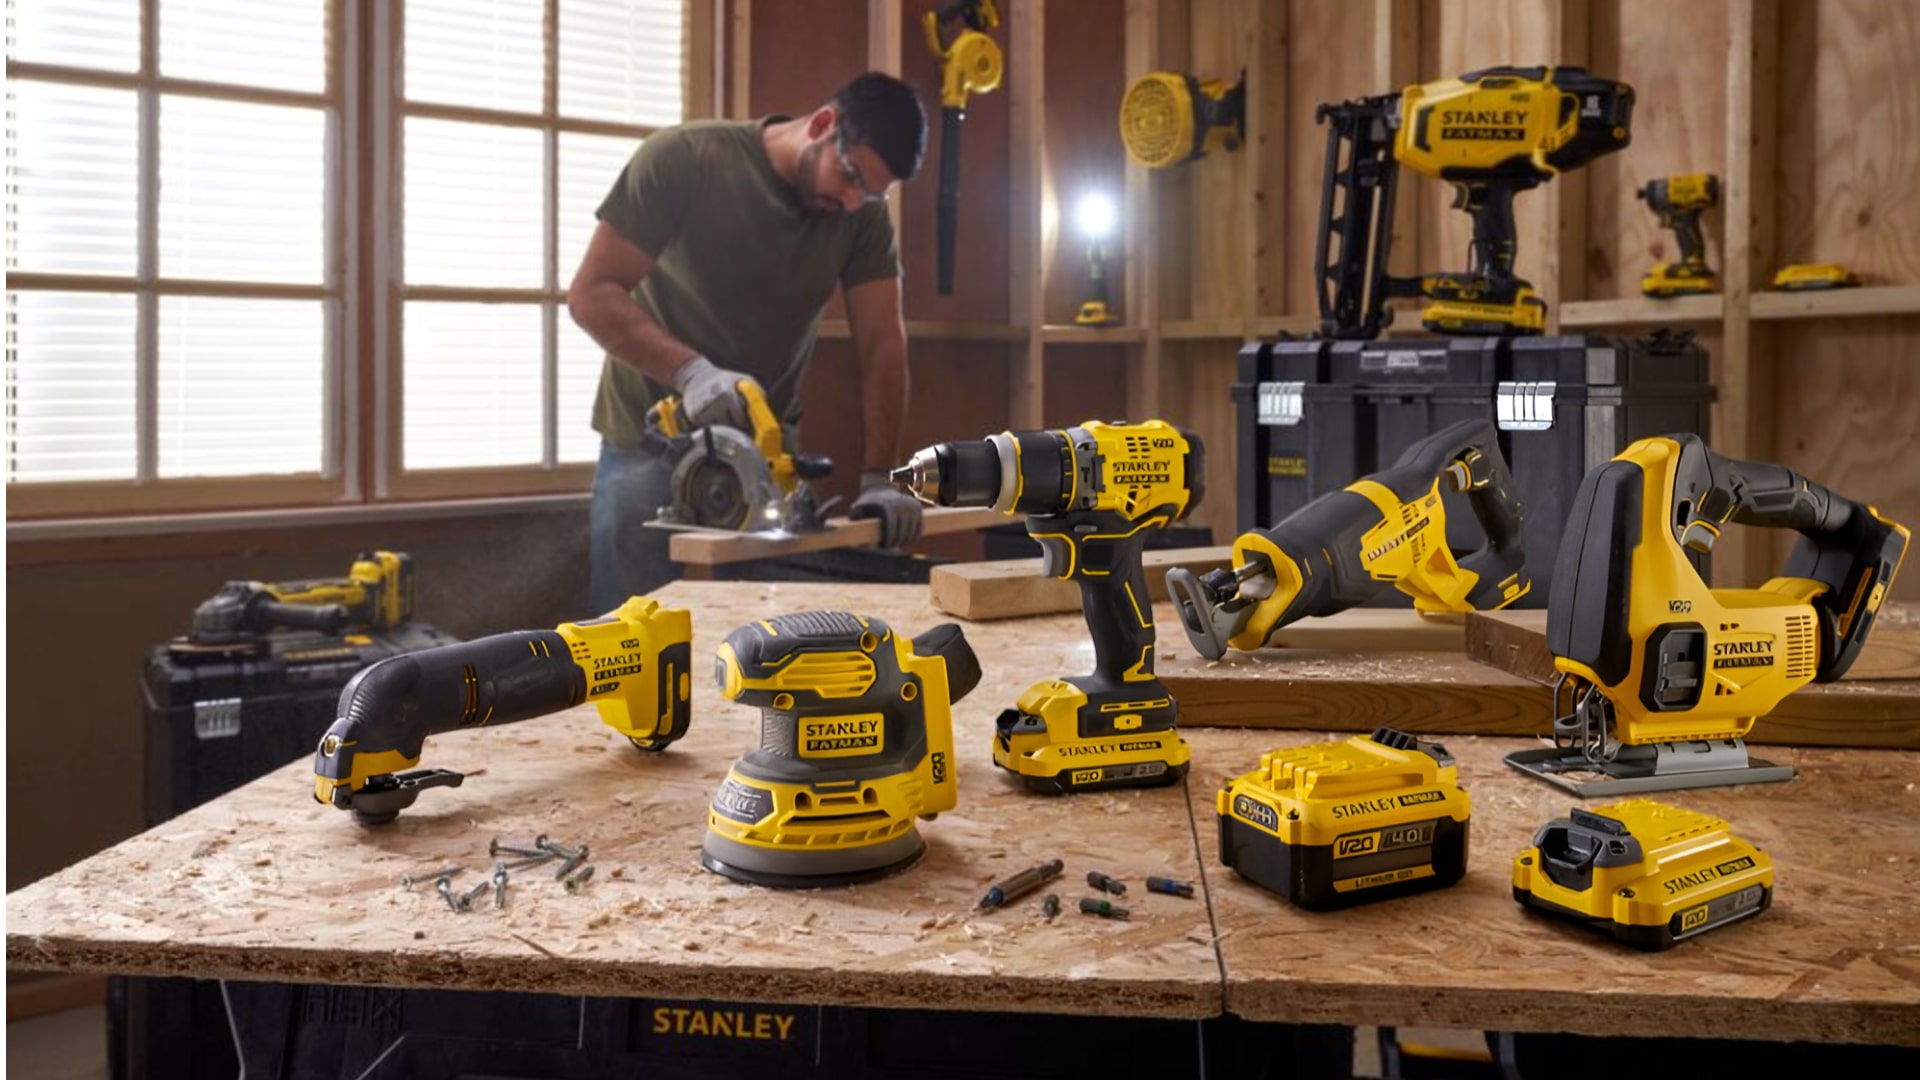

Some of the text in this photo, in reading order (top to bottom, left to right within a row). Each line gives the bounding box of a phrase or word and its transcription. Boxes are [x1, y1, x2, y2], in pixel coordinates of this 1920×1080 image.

[1442, 110, 1528, 125] STANLEY
[1444, 129, 1523, 139] FATMAX
[1112, 461, 1169, 472] STANLEY
[1713, 640, 1773, 655] STANLEY
[593, 653, 641, 670] STANLEY
[806, 719, 878, 736] STANLEY
[808, 736, 877, 750] FATMAX
[1059, 744, 1117, 757] STANLEY
[1332, 797, 1396, 819] STANLEY
[1339, 836, 1374, 855] V20
[1664, 868, 1717, 895] STANLEY
[653, 1007, 795, 1040] STANLEY
